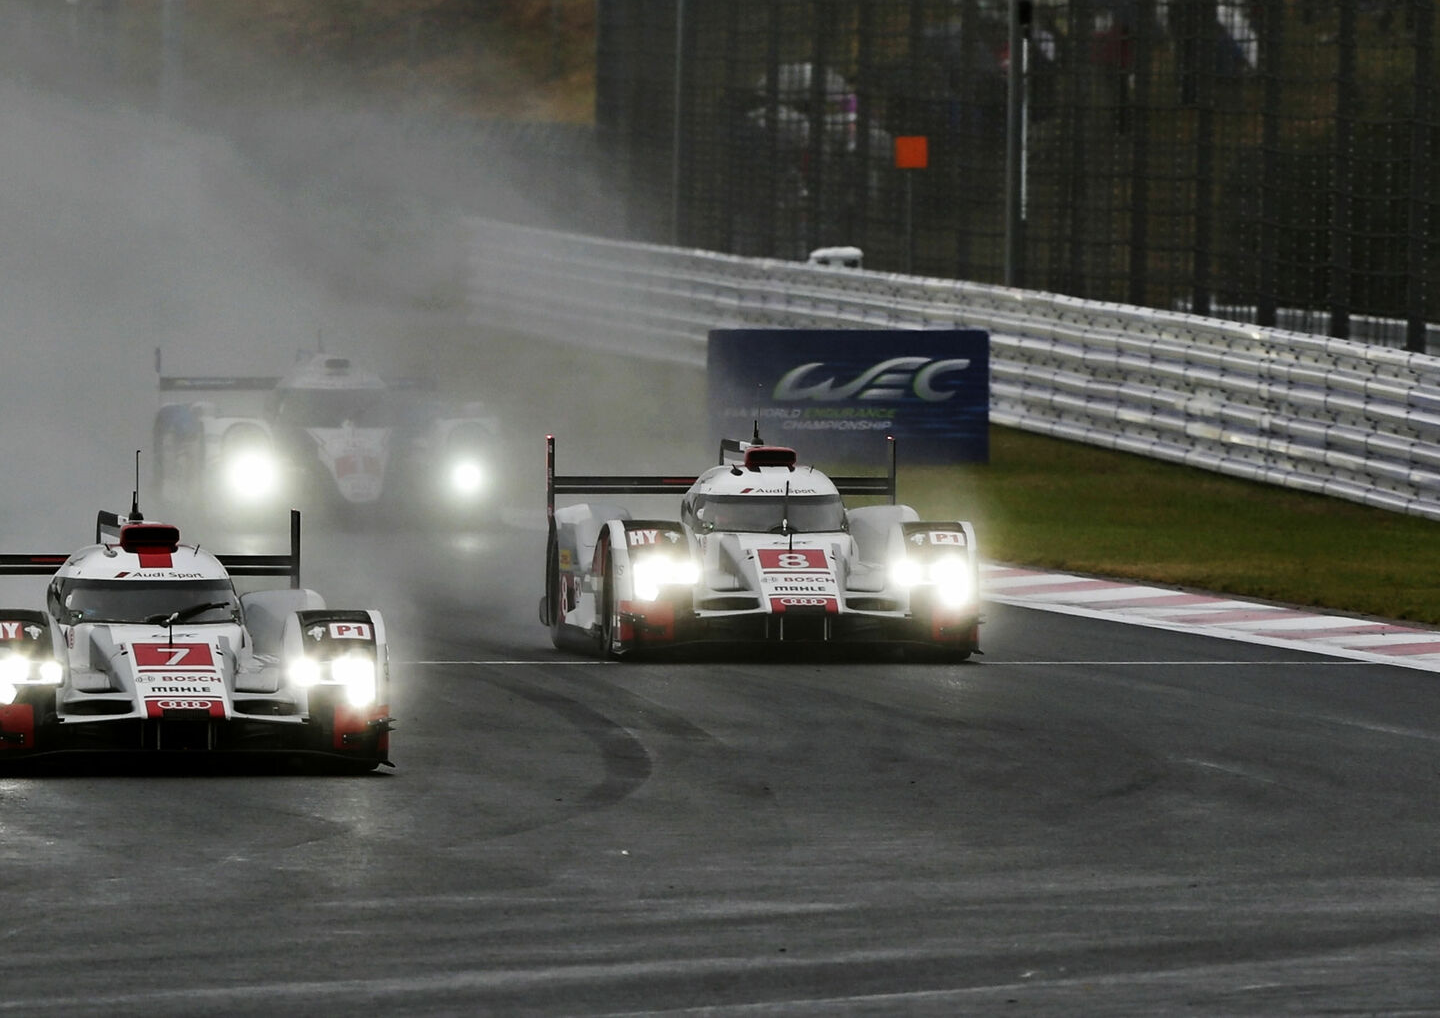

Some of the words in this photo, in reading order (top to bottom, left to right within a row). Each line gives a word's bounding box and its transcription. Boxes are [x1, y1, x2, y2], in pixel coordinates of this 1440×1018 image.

[772, 356, 971, 402] WEC
[751, 408, 801, 418] WORLD
[803, 407, 898, 419] ENDURANCE
[782, 420, 893, 431] CHAMPIONSHIP
[628, 530, 658, 545] HY
[935, 534, 959, 543] P1
[778, 553, 809, 568] 8
[168, 571, 205, 579] Sport
[336, 625, 365, 637] P1
[157, 648, 190, 665] 7
[161, 676, 222, 684] BOSCH
